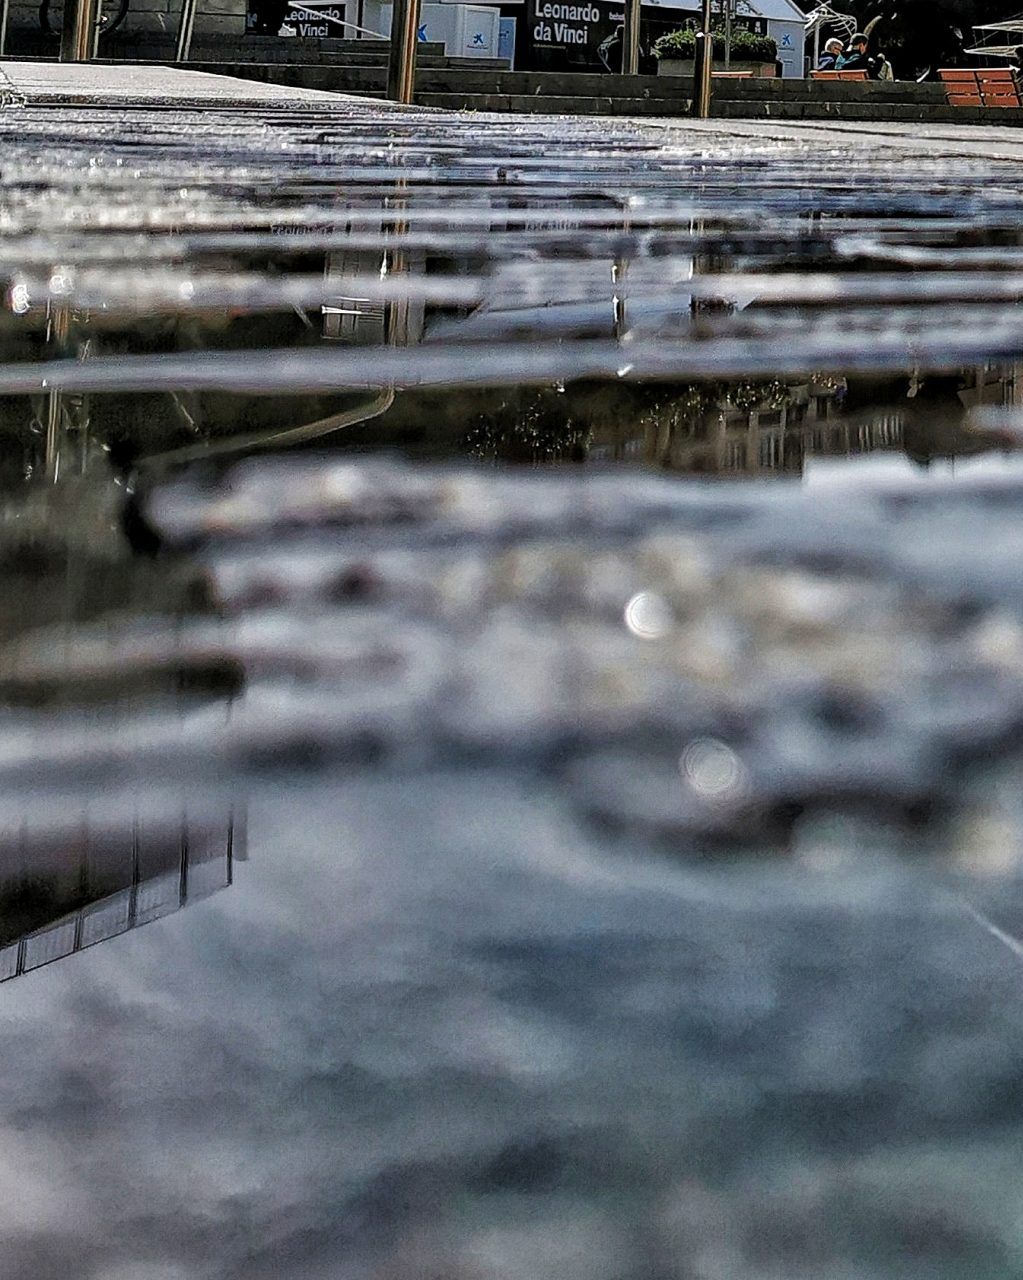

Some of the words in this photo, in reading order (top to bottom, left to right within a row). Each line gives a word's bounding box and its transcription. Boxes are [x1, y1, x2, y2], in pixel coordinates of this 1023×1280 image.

[299, 23, 329, 37] Vinci
[533, 21, 552, 42] da
[553, 22, 588, 45] Vinci
